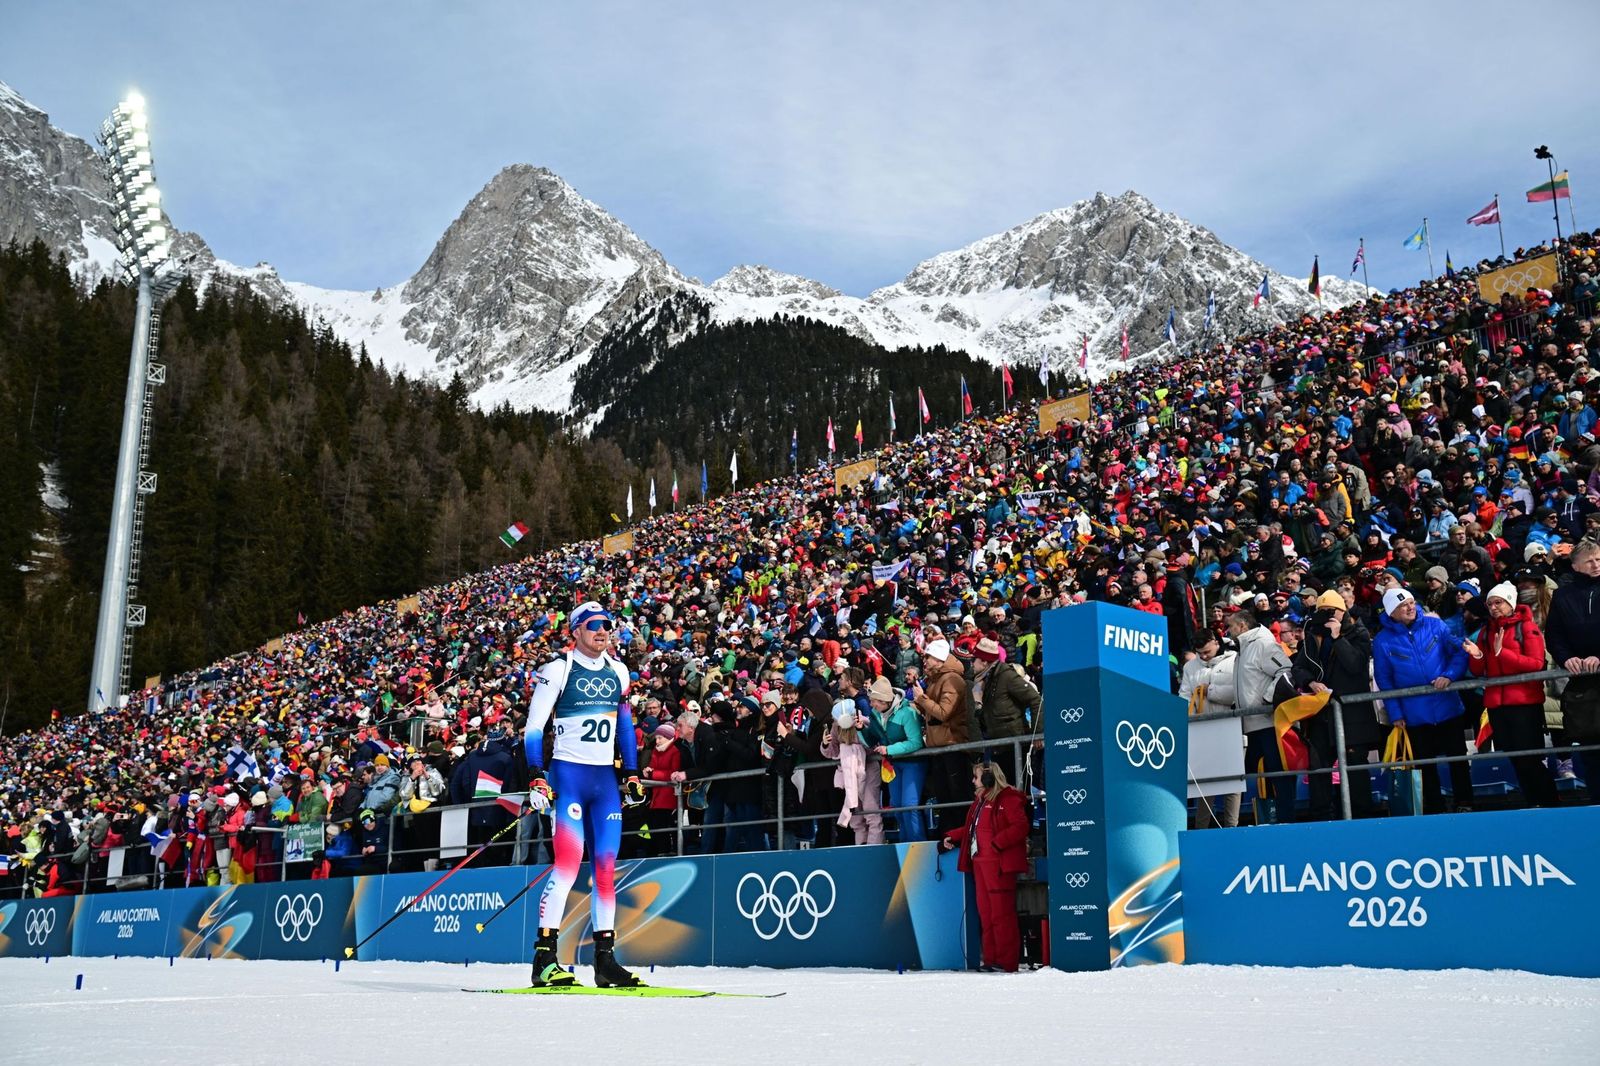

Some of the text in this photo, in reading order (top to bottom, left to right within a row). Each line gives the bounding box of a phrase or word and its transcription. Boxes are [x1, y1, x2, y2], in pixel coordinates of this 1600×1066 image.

[1103, 624, 1163, 657] FINISH
[580, 719, 611, 743] 20
[1222, 853, 1577, 895] MILANO CORTINA
[394, 892, 506, 913] MILANO CORTINA
[1347, 896, 1428, 928] 2026
[96, 907, 160, 923] MILANO CORTINA
[433, 915, 460, 933] 2026
[117, 924, 134, 938] 2026
